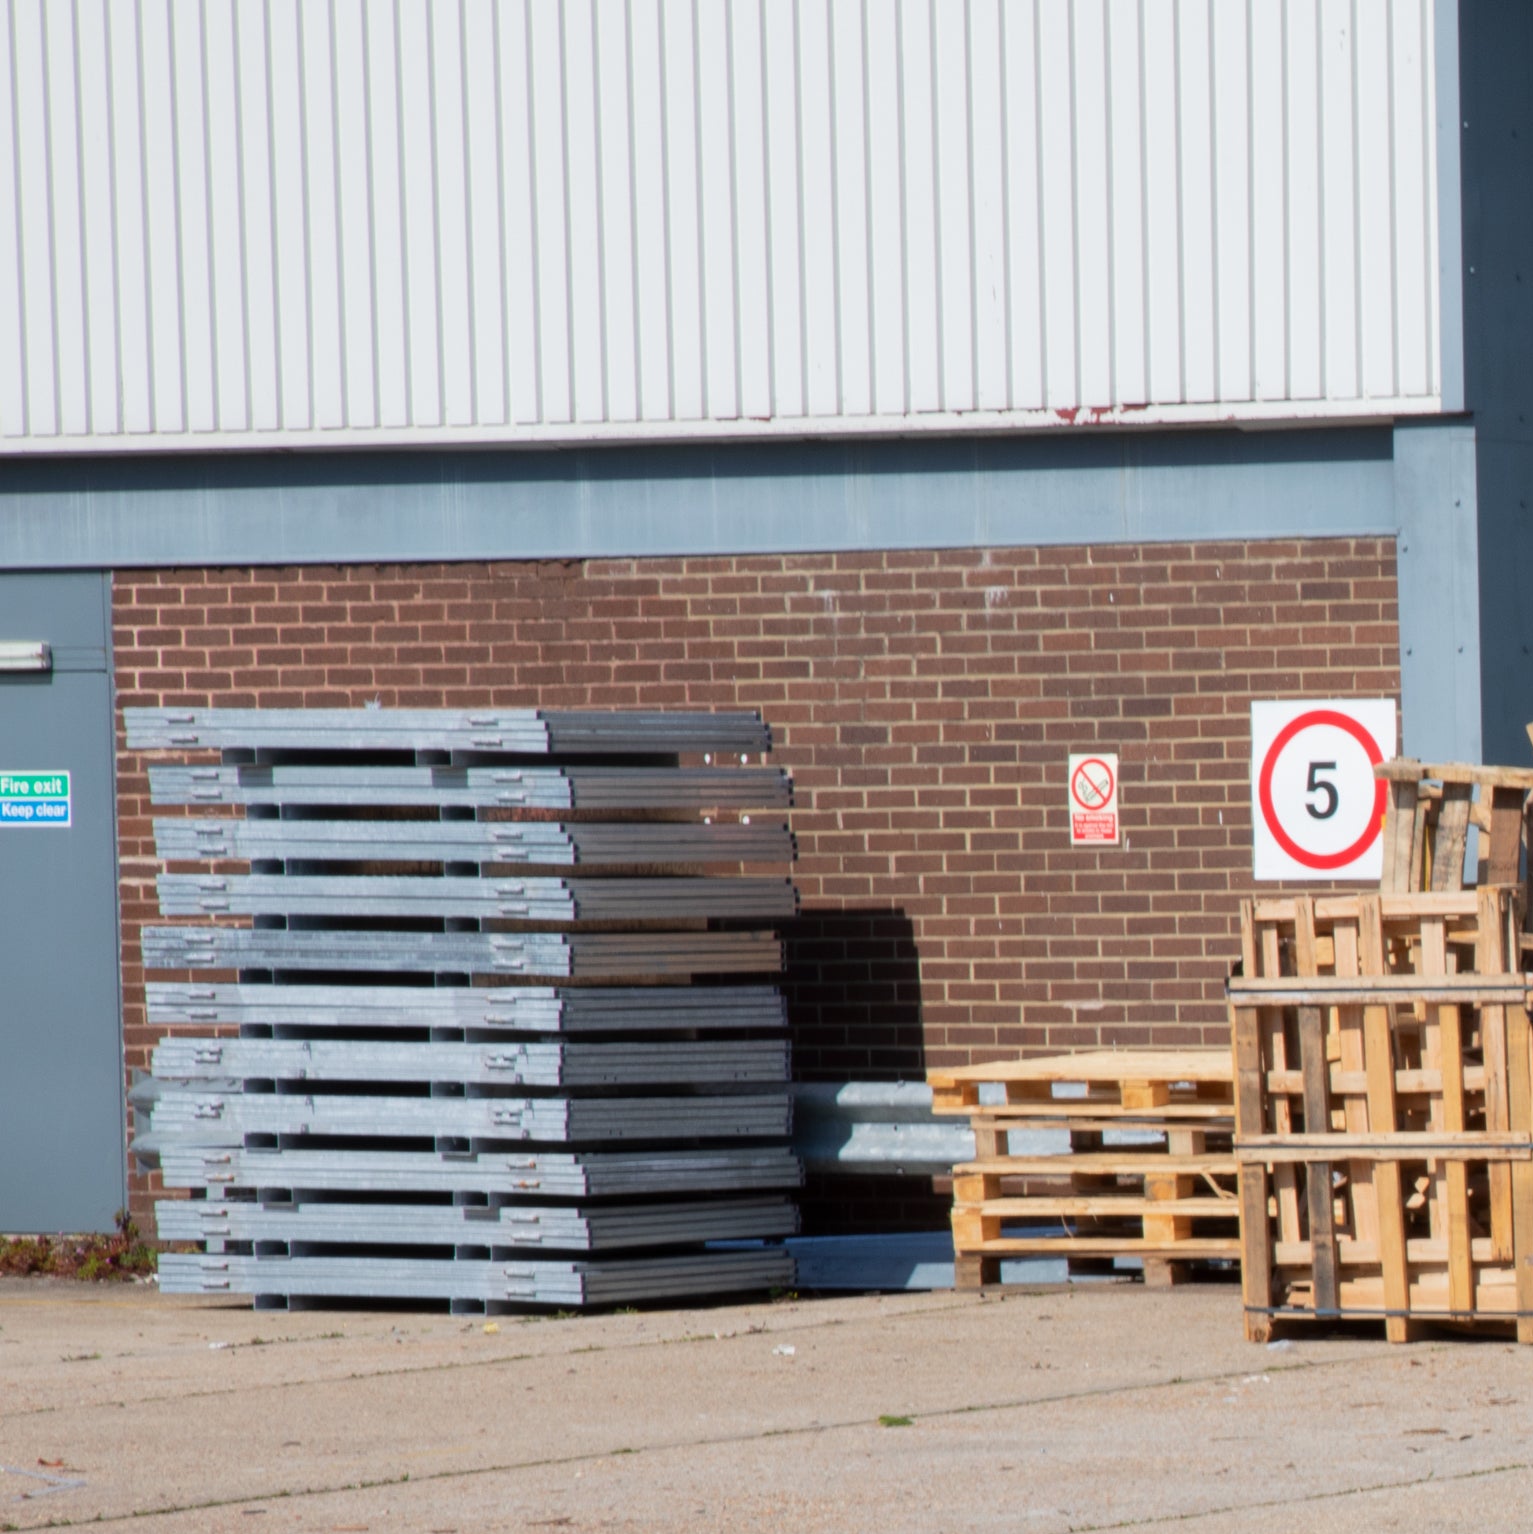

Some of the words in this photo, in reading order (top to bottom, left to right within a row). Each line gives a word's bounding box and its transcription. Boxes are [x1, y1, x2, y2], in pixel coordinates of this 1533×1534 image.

[1, 777, 29, 794] Fire
[34, 777, 62, 794] exit
[1305, 761, 1338, 819] 5
[2, 802, 34, 820] Keep
[36, 801, 66, 817] clear
